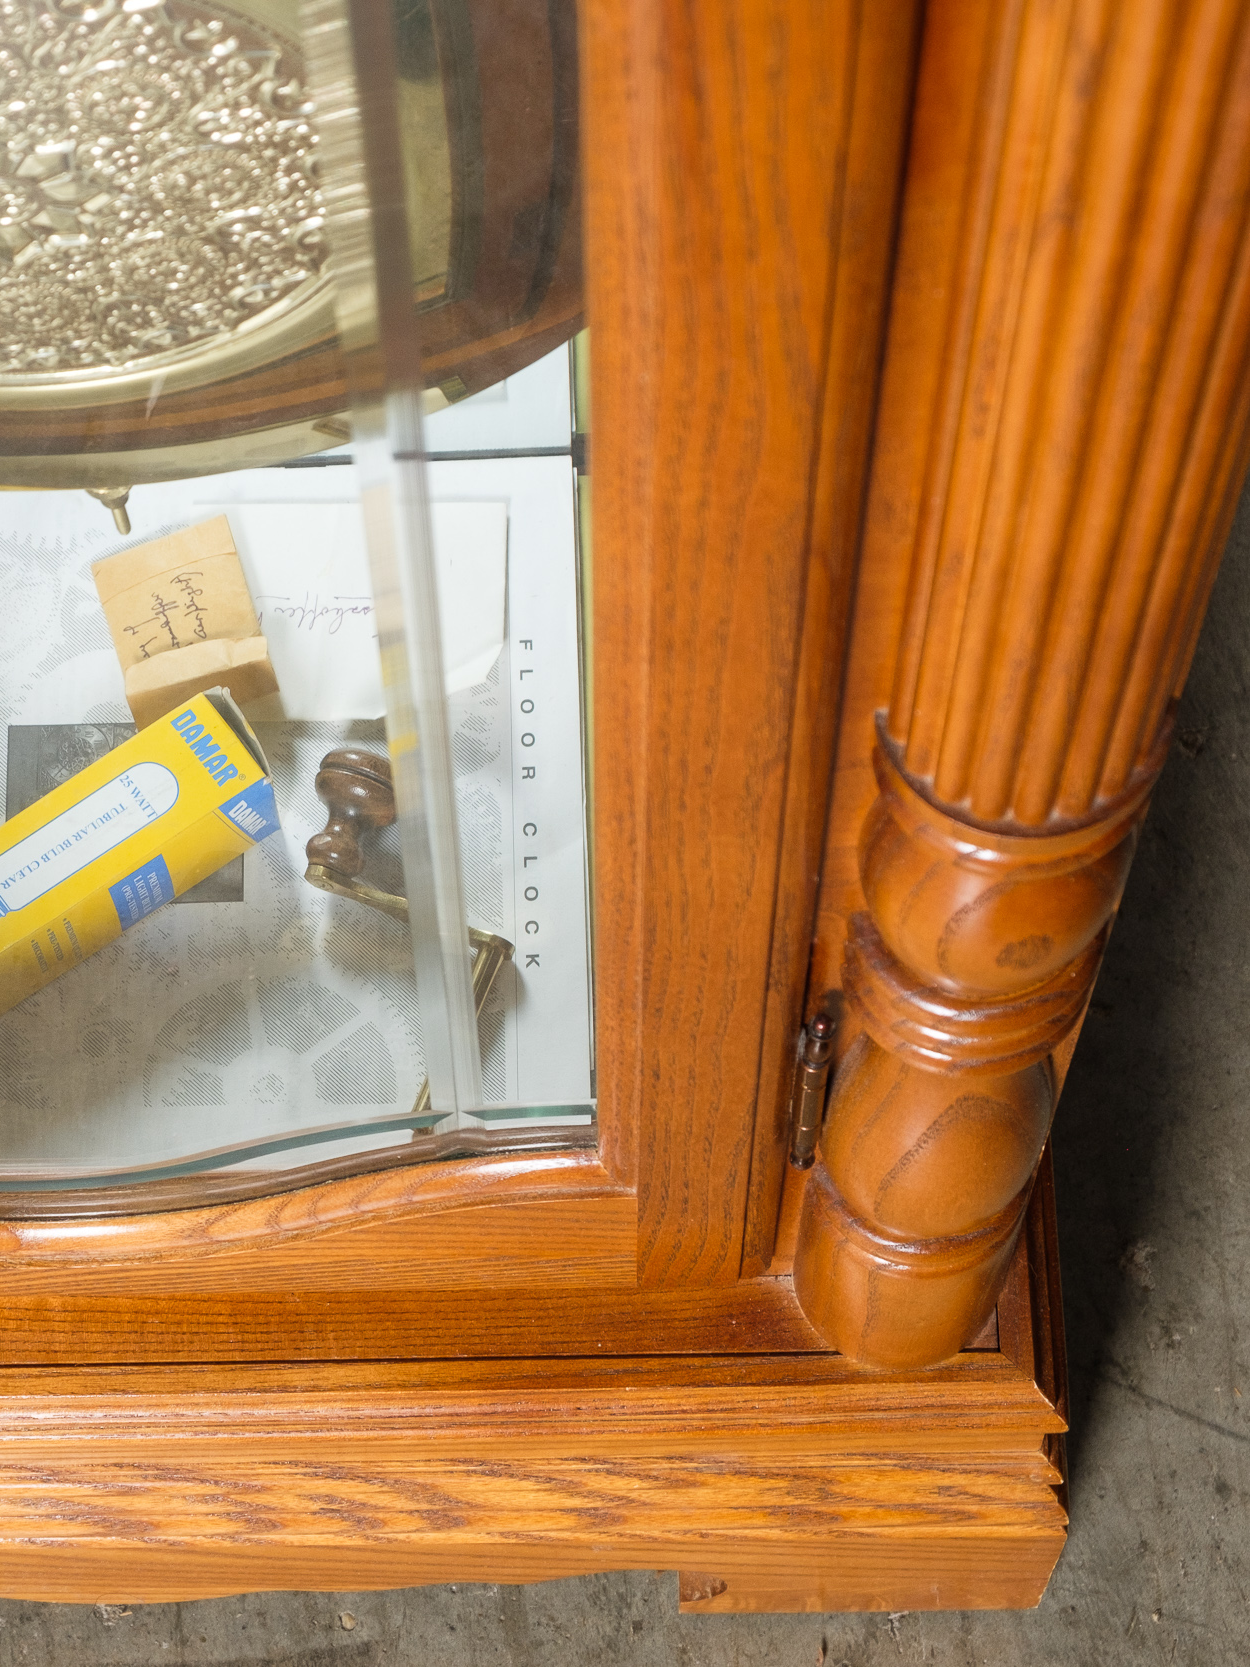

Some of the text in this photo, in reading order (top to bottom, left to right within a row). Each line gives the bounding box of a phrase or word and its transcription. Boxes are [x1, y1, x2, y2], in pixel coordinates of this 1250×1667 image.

[119, 774, 158, 819] 25 WATT
[518, 639, 541, 968] FLOOR CLOCK
[0, 802, 129, 890] TUBULAR BULB CLEAR
[133, 875, 150, 899] LIGHT
